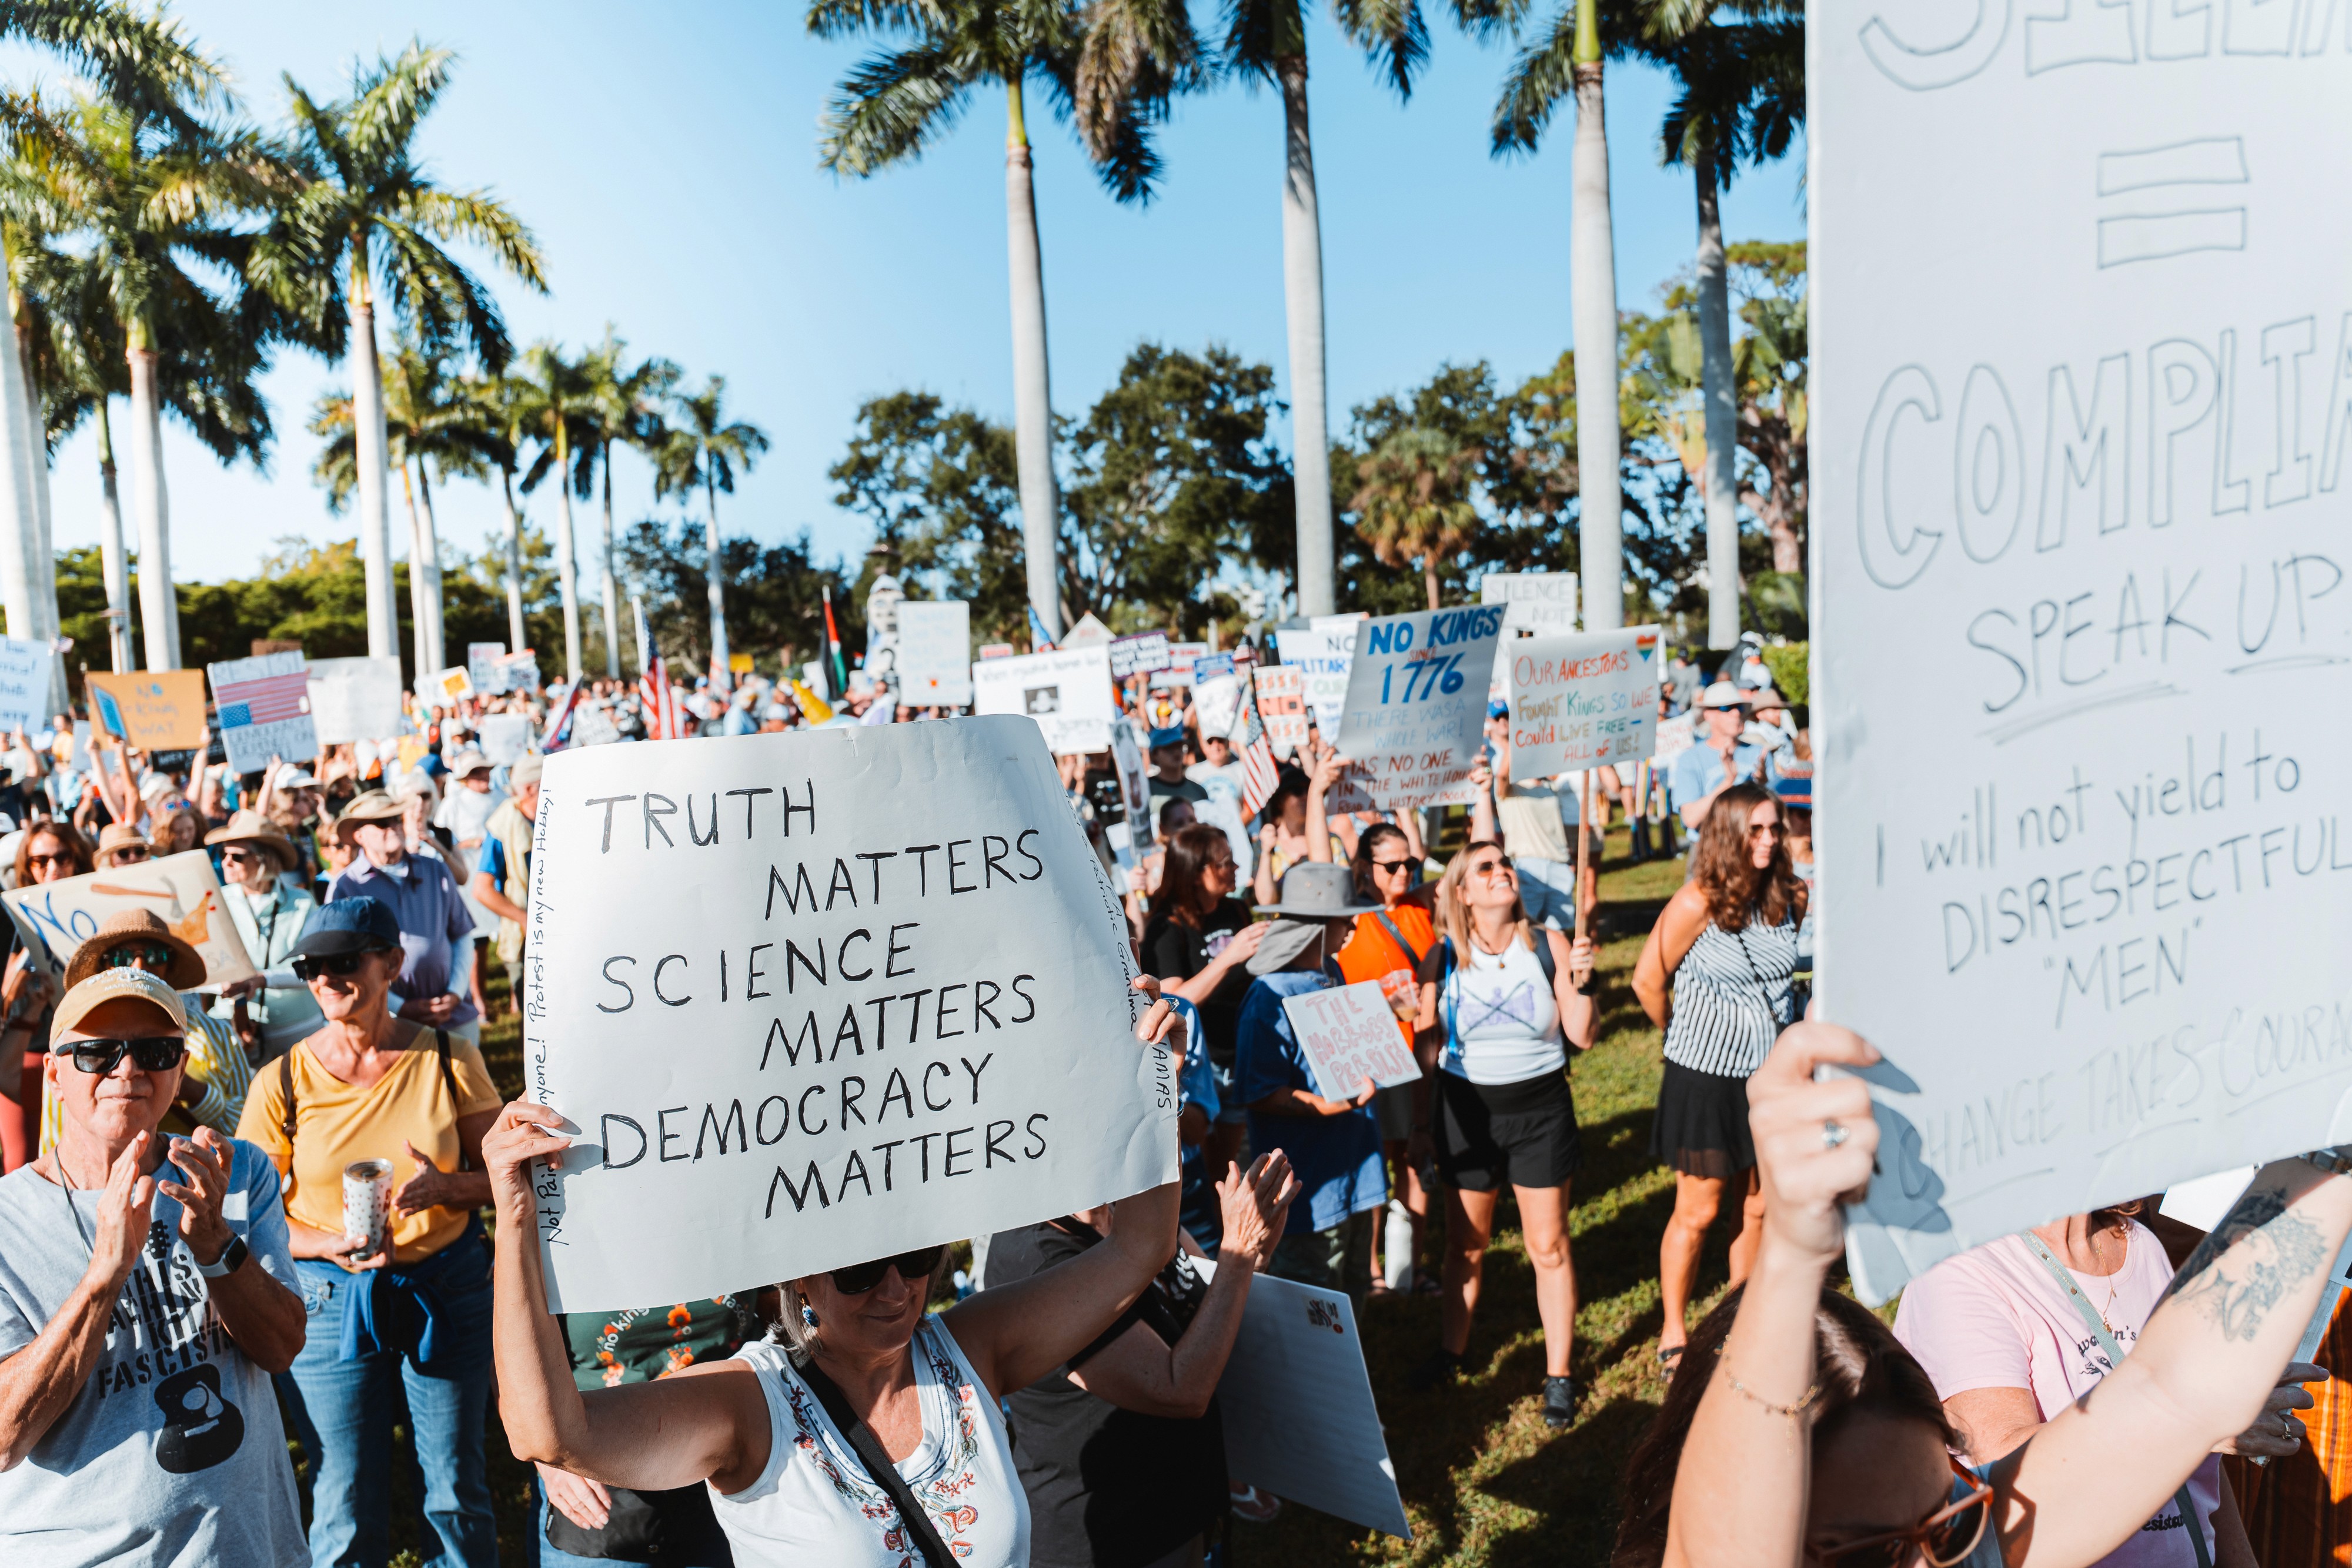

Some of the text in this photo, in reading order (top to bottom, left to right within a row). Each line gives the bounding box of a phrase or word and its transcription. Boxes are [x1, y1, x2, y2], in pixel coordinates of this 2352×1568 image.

[1488, 579, 1572, 604] SILENCE
[1368, 621, 1414, 655] NO
[1426, 607, 1502, 648] KINGS
[1532, 606, 1572, 624] NOT
[1408, 645, 1438, 663] SINCE
[1967, 568, 2212, 713] SPEAK
[1282, 658, 1352, 673] MILITAR
[1380, 651, 1465, 704] 1776
[1557, 650, 1629, 683] ANCESTORS
[1352, 708, 1411, 729] THERE
[1419, 702, 1453, 723] WAS
[1453, 697, 1465, 713] A
[1611, 691, 1626, 711] SO
[1631, 686, 1654, 709] WE
[1373, 715, 1464, 749] WHOLE WAR!
[1515, 724, 1555, 748] Could
[1596, 717, 1627, 734] FREE
[1563, 743, 1591, 764] ALL
[1616, 731, 1641, 755] US!
[1338, 768, 1472, 797] IN THE WHITE HOU
[1388, 754, 1414, 773] NO
[1419, 748, 1454, 769] ONE
[534, 788, 554, 852] Hobby!
[584, 777, 817, 855] TRUTH
[1388, 792, 1436, 810] HISTORY
[1439, 788, 1476, 803] BOOK?
[1877, 728, 2301, 888] I will not yield to
[535, 859, 544, 896] new
[764, 828, 1044, 921] MATTERS
[1942, 815, 2352, 975] DISRESPECTFUL
[534, 900, 554, 924] my
[531, 929, 544, 947] is
[104, 982, 154, 992] MARYLAND
[527, 951, 546, 1022] Protest
[594, 921, 922, 1014] SCIENCE
[1117, 941, 1140, 1032] Grandma
[759, 973, 1037, 1072] MATTERS
[1305, 988, 1364, 1027] THE
[1307, 1011, 1396, 1066] HORRORS
[527, 1037, 555, 1106] nyone!
[1151, 1042, 1172, 1109] AMAS
[2078, 1023, 2206, 1135] TAKES
[2219, 1001, 2352, 1098] COURA
[600, 1052, 995, 1171] DEMOCRACY
[764, 1112, 1050, 1220] MATTERS
[538, 1206, 570, 1246] Not
[124, 1253, 192, 1298] HIS
[603, 1307, 650, 1352] no king
[97, 1320, 234, 1399] FASCIST
